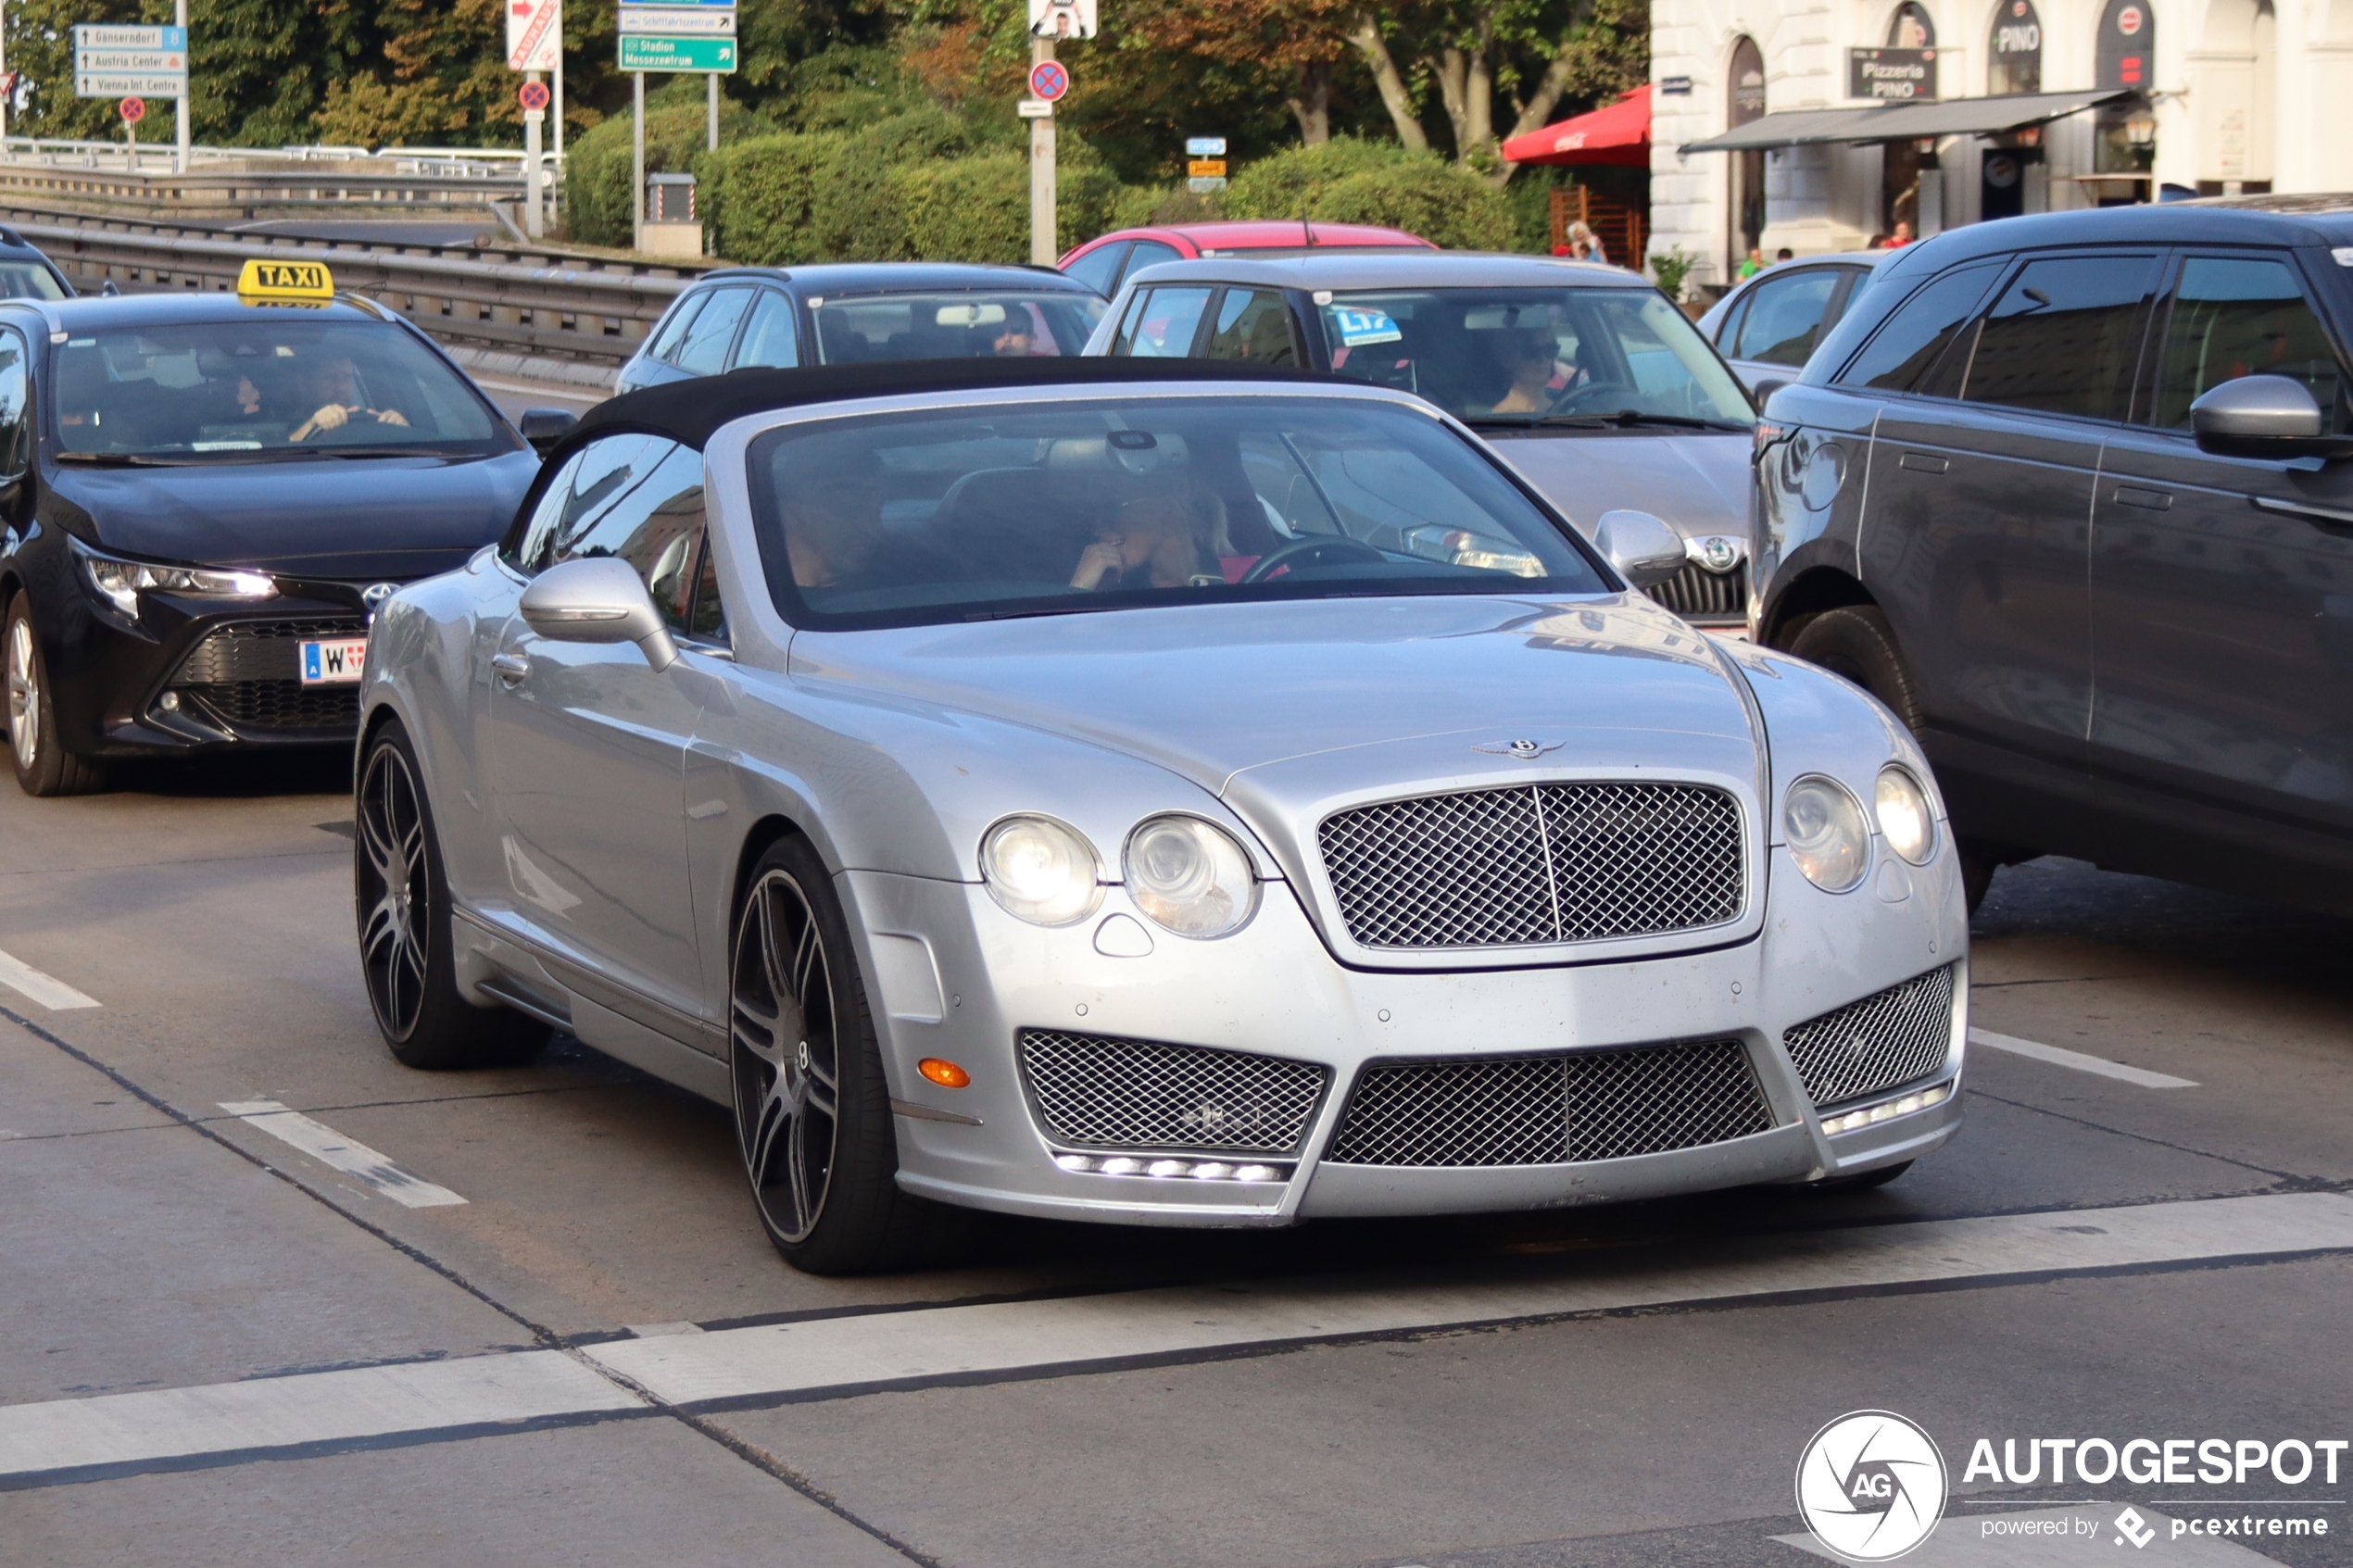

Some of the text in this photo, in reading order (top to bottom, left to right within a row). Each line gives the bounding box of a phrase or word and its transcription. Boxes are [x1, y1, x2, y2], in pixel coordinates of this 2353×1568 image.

[95, 31, 179, 45] Gänserndorf 8
[640, 40, 675, 52] Stadion
[1998, 24, 2039, 53] PINO
[95, 56, 163, 68] Austria Center
[625, 54, 693, 66] Messezentrum
[1862, 62, 1925, 80] Pizzeria
[98, 79, 128, 91] Vienna
[148, 79, 178, 91] Centre
[1872, 82, 1915, 98] PINO
[260, 266, 320, 287] TAXI
[1339, 311, 1390, 332] L17
[325, 647, 345, 674] W
